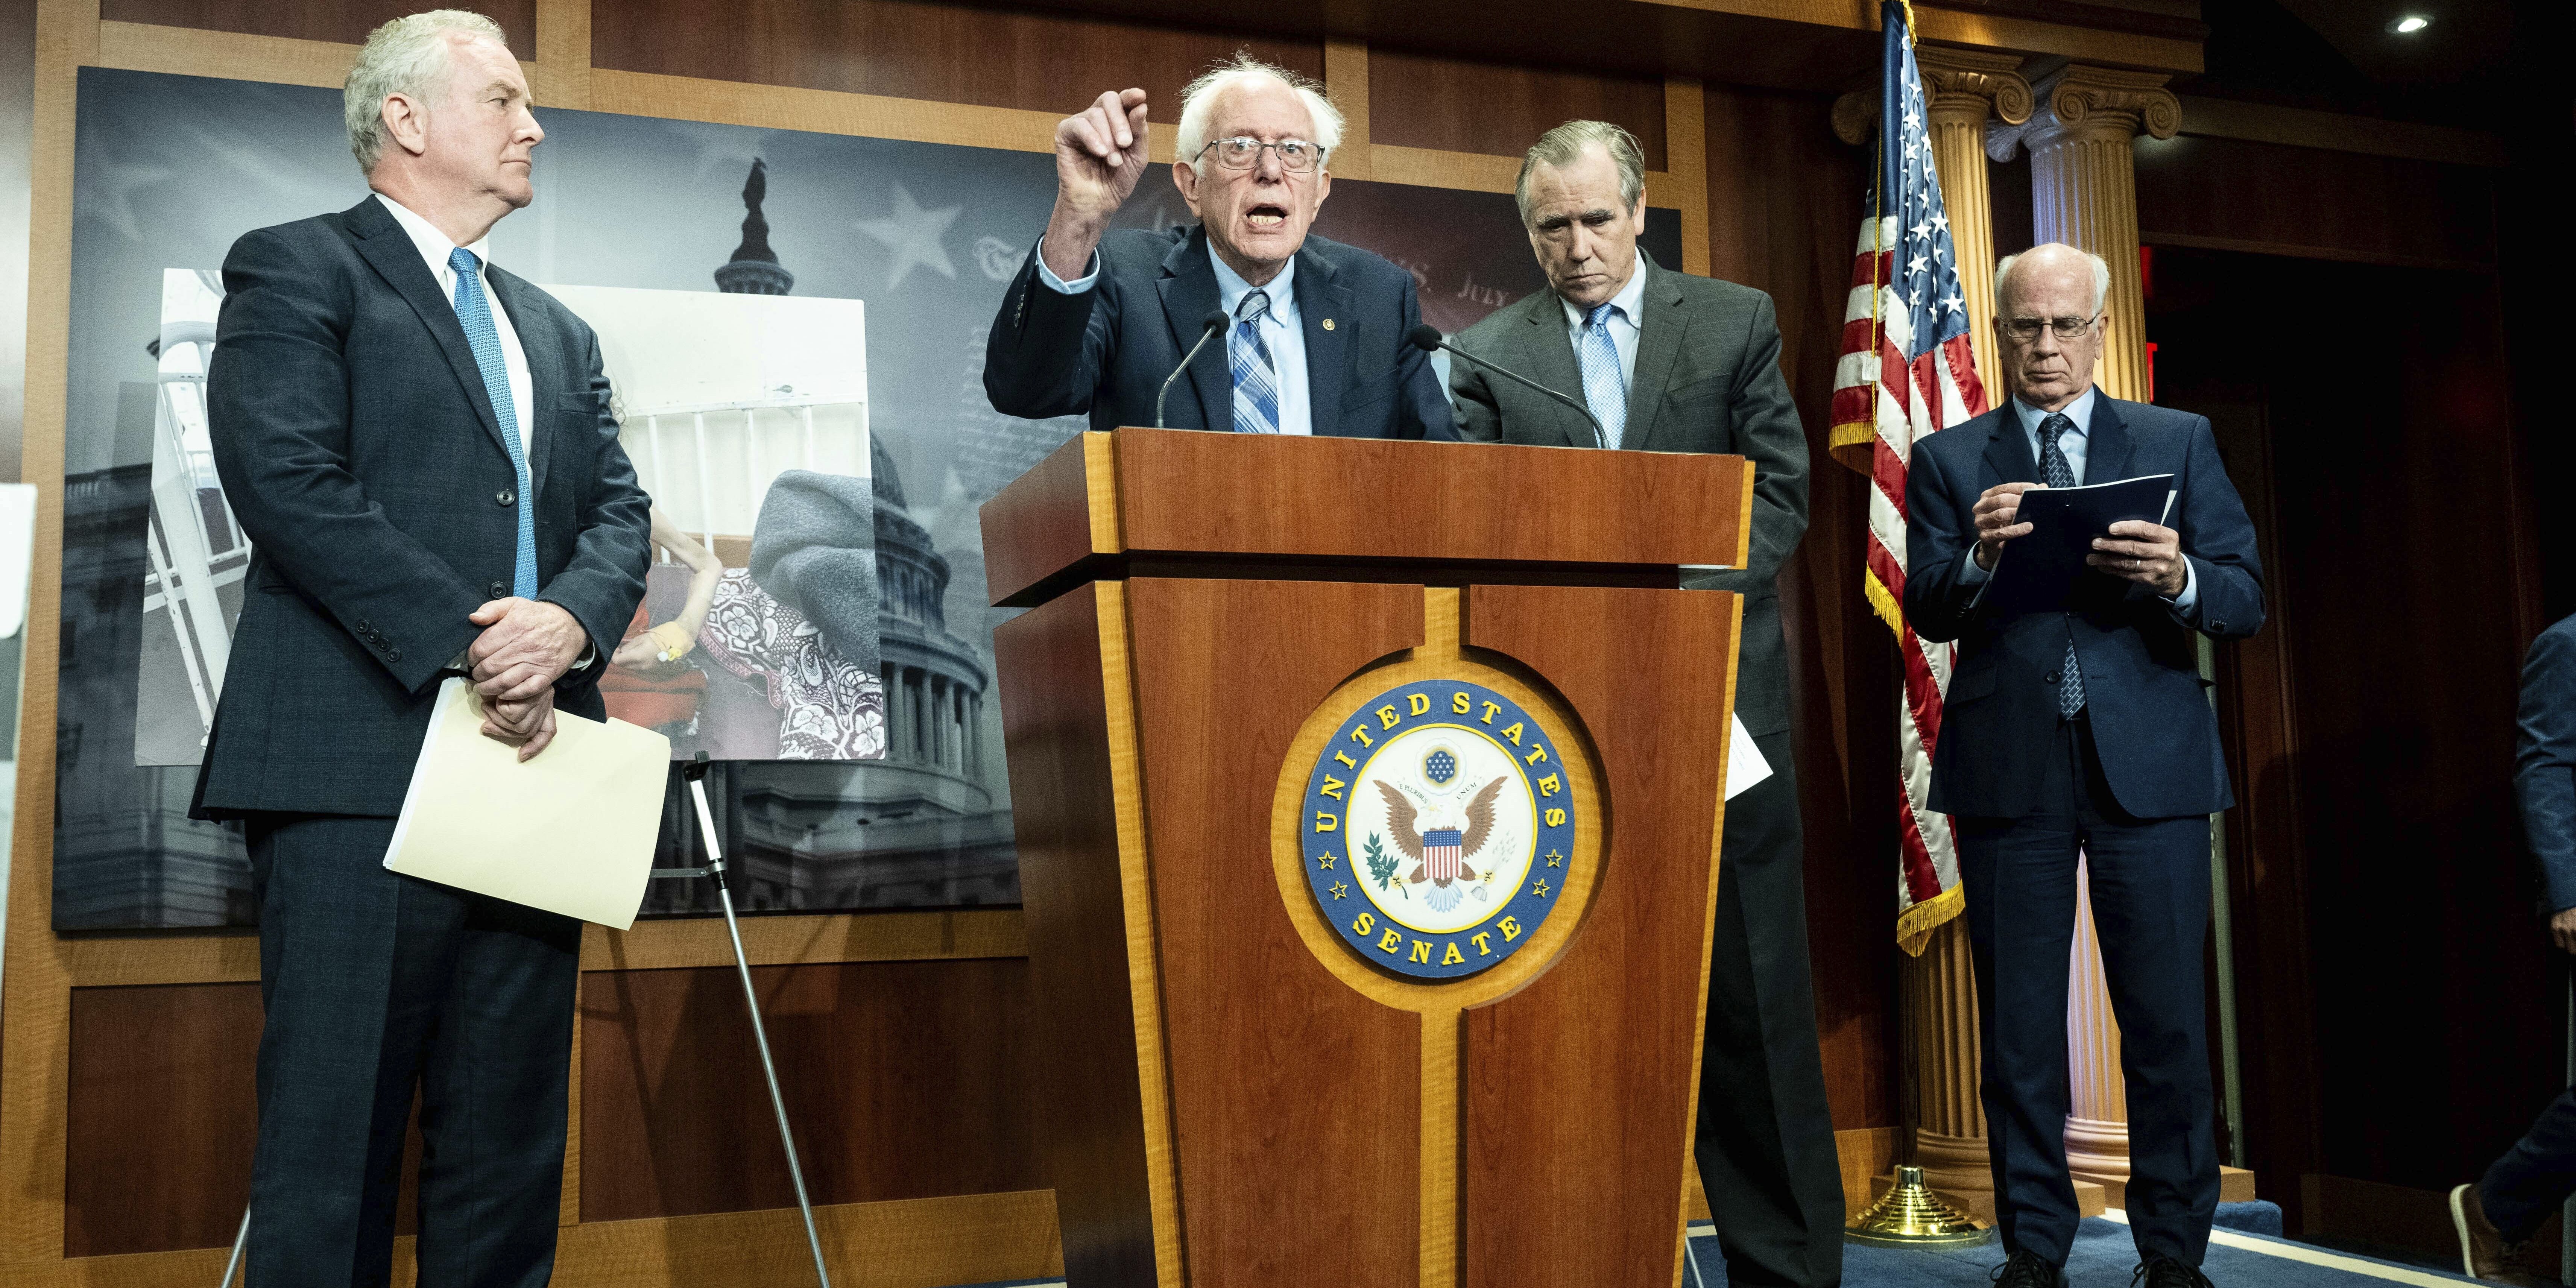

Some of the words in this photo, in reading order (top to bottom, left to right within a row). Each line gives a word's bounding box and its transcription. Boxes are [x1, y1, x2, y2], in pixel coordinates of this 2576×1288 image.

[1316, 693, 1430, 833] UNITED
[1452, 692, 1566, 828] STATES
[1404, 785, 1428, 804] PLURIBUS
[1456, 782, 1477, 800] UNUM
[1353, 912, 1521, 966] SENATE
